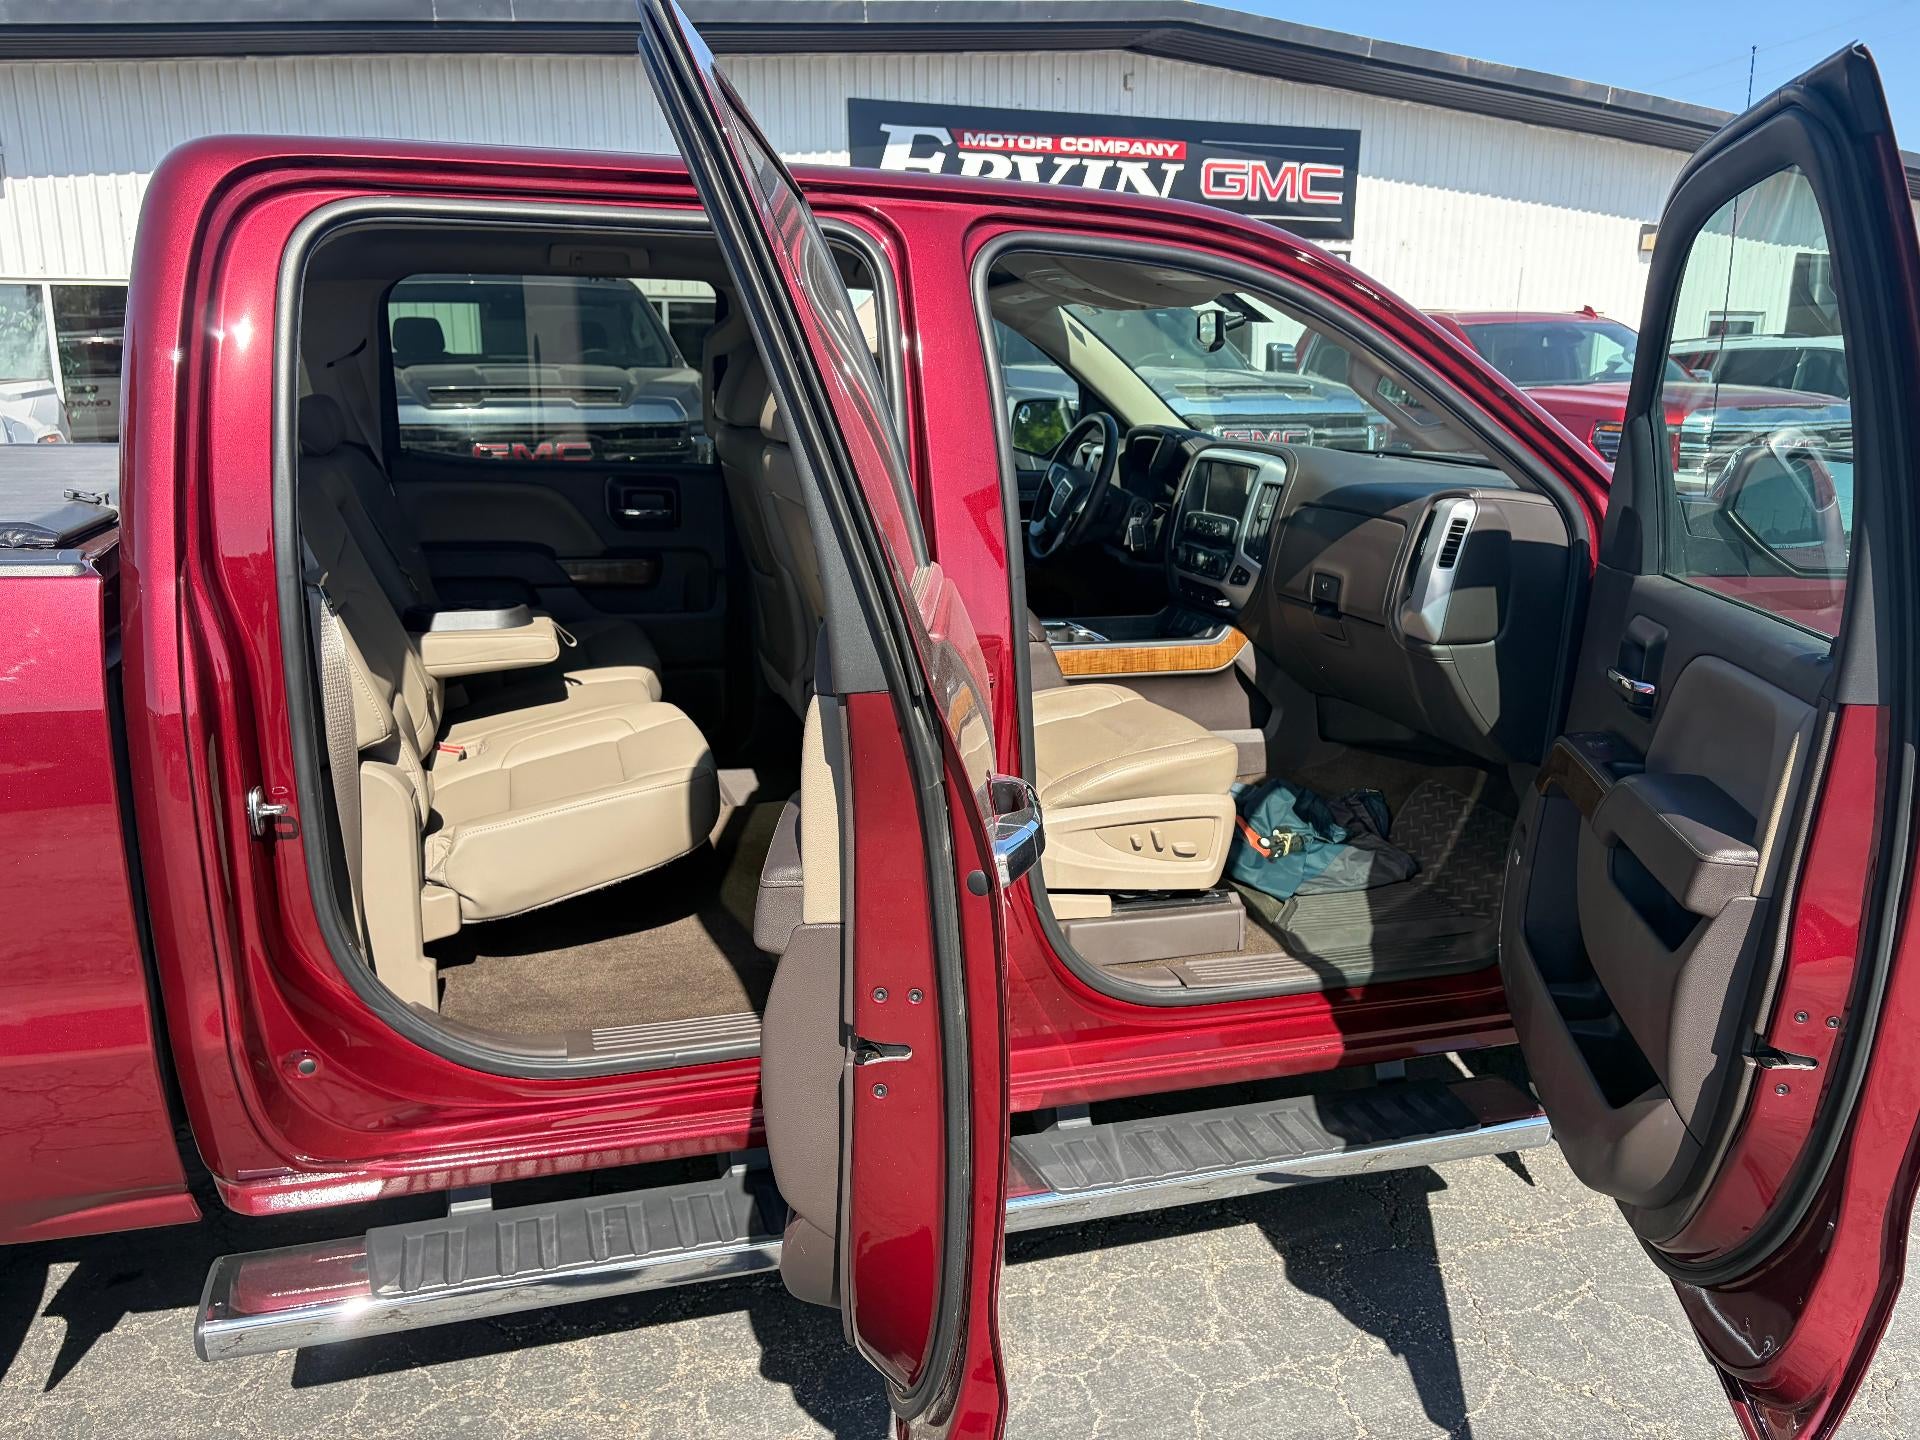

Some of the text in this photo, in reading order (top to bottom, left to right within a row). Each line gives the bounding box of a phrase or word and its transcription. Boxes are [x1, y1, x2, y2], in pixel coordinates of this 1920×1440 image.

[963, 132, 1180, 157] MOTOR COMPANY
[1200, 158, 1345, 205] GMC
[473, 441, 593, 461] GMC
